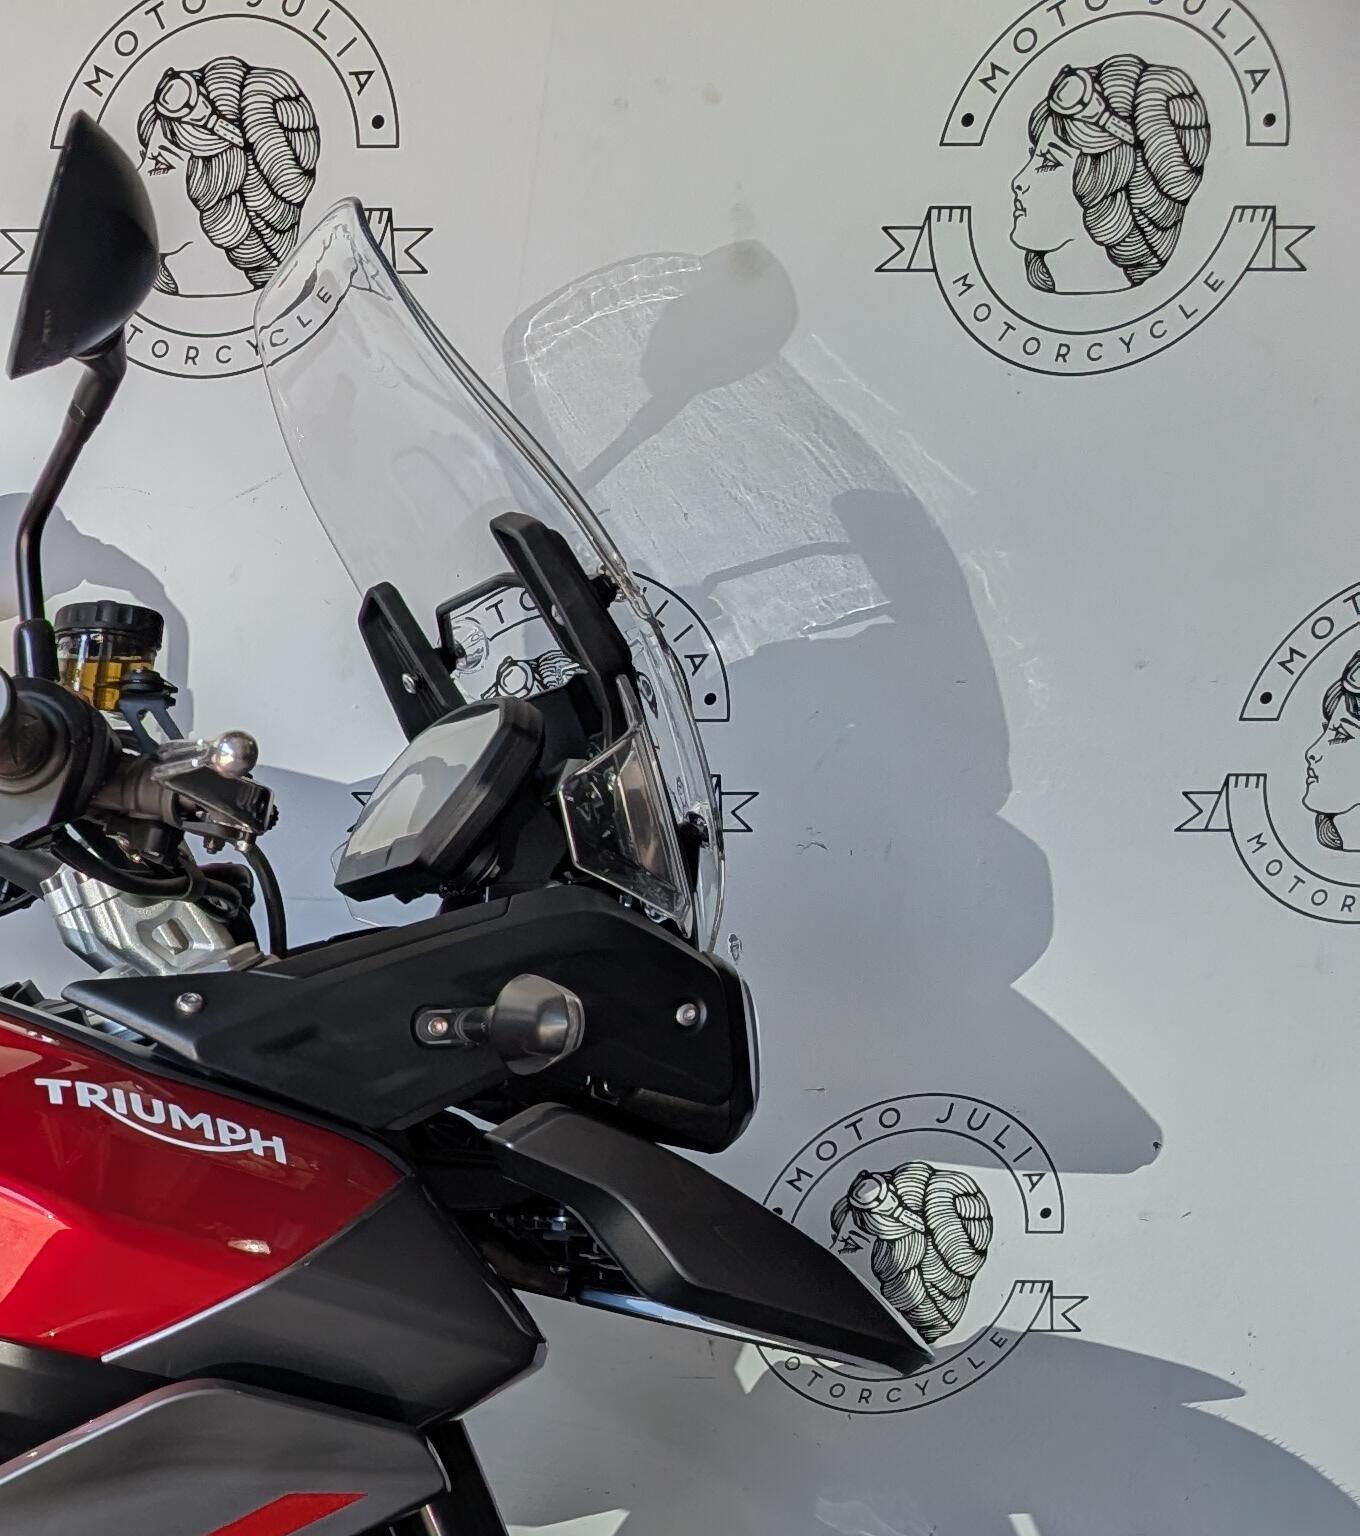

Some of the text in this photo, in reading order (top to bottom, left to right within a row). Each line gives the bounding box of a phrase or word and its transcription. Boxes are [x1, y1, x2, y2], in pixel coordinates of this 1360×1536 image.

[244, 0, 377, 96] ULIA
[1148, 0, 1272, 95] ULIA
[126, 286, 333, 366] TORCYCLE
[952, 270, 1226, 364] MOTORCYCLE
[650, 594, 709, 677] LIA
[1277, 591, 1360, 676] MOT
[1246, 832, 1356, 913] MOTOR
[34, 1078, 287, 1165] TRIUMPH
[785, 1102, 1047, 1193] MOTO JULIA
[783, 1330, 1009, 1404] OTORCYCLE
